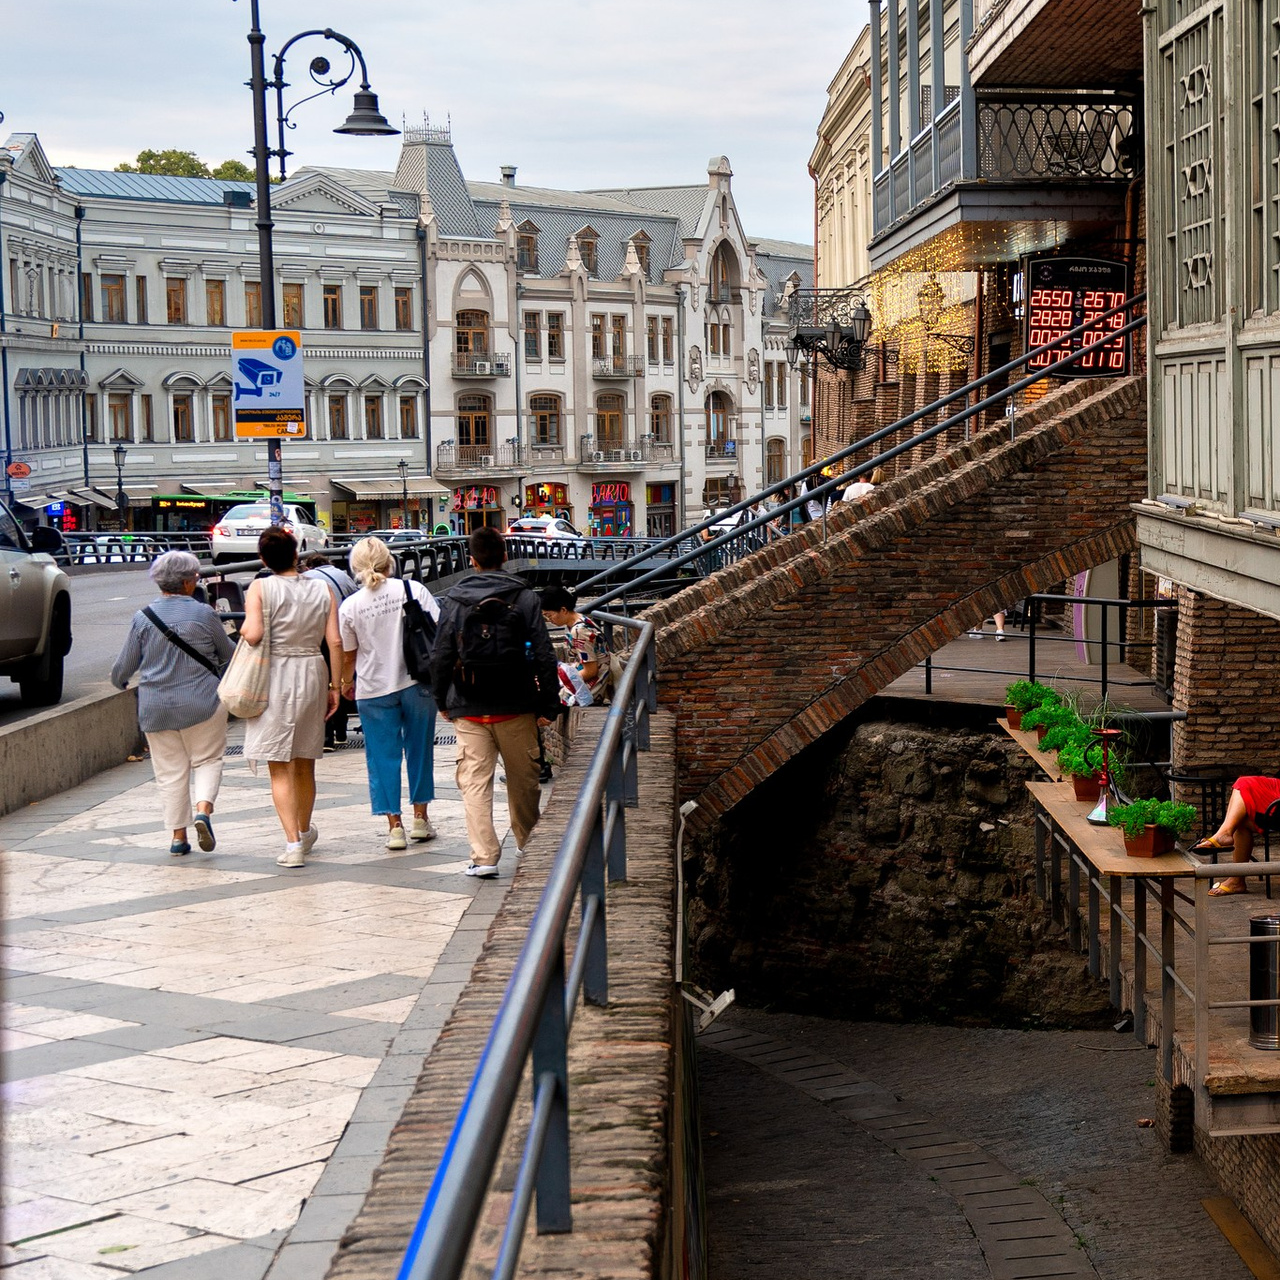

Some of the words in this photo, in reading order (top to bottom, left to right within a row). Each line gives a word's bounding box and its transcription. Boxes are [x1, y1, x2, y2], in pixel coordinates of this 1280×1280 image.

[1031, 289, 1072, 307] 2650
[1083, 291, 1125, 308] 2670
[1031, 310, 1072, 327] 2828
